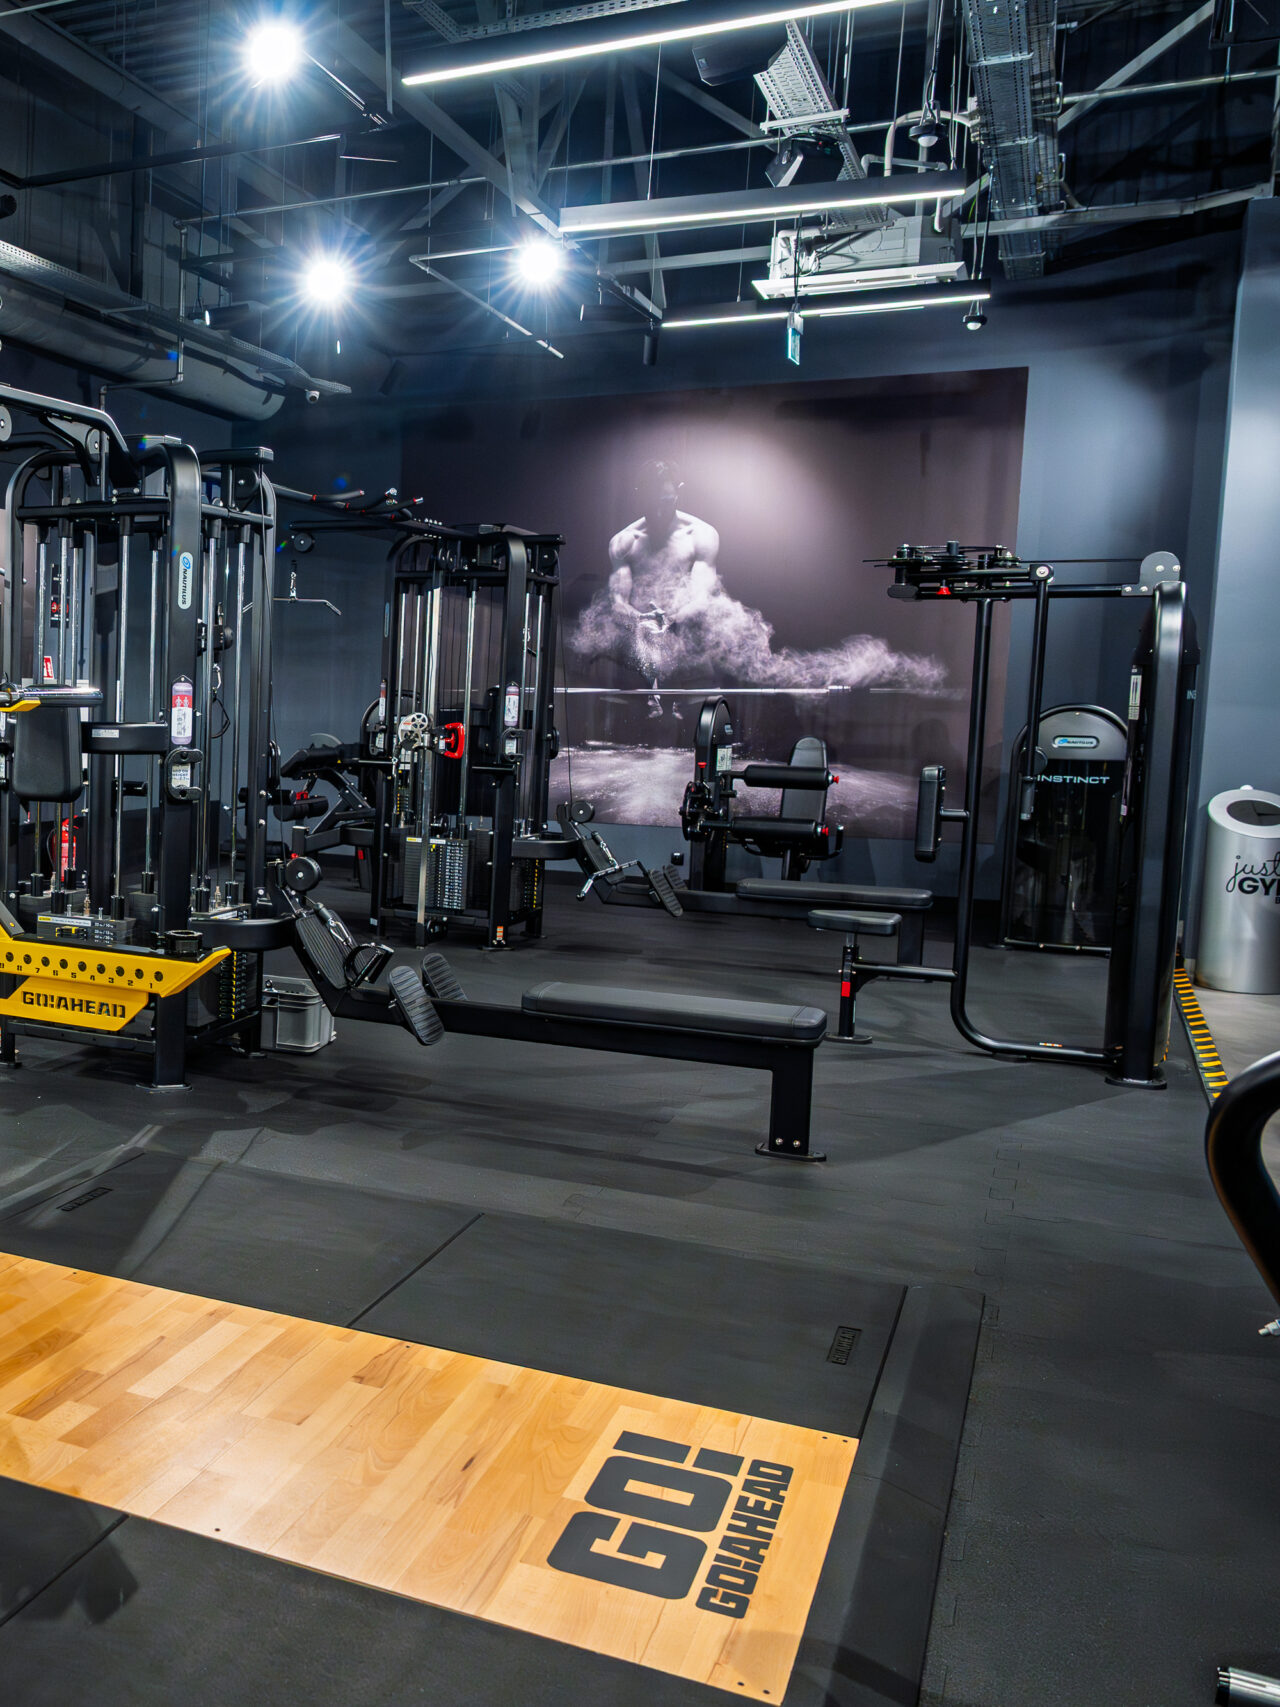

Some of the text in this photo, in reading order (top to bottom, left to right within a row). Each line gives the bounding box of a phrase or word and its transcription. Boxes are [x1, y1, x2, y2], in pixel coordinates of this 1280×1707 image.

[181, 568, 189, 606] NAUTILUS
[1037, 774, 1110, 784] INSTINCT
[22, 990, 126, 1019] GO!AHEAD
[546, 1430, 744, 1600] GO!
[694, 1458, 794, 1619] GO!AHEAD
